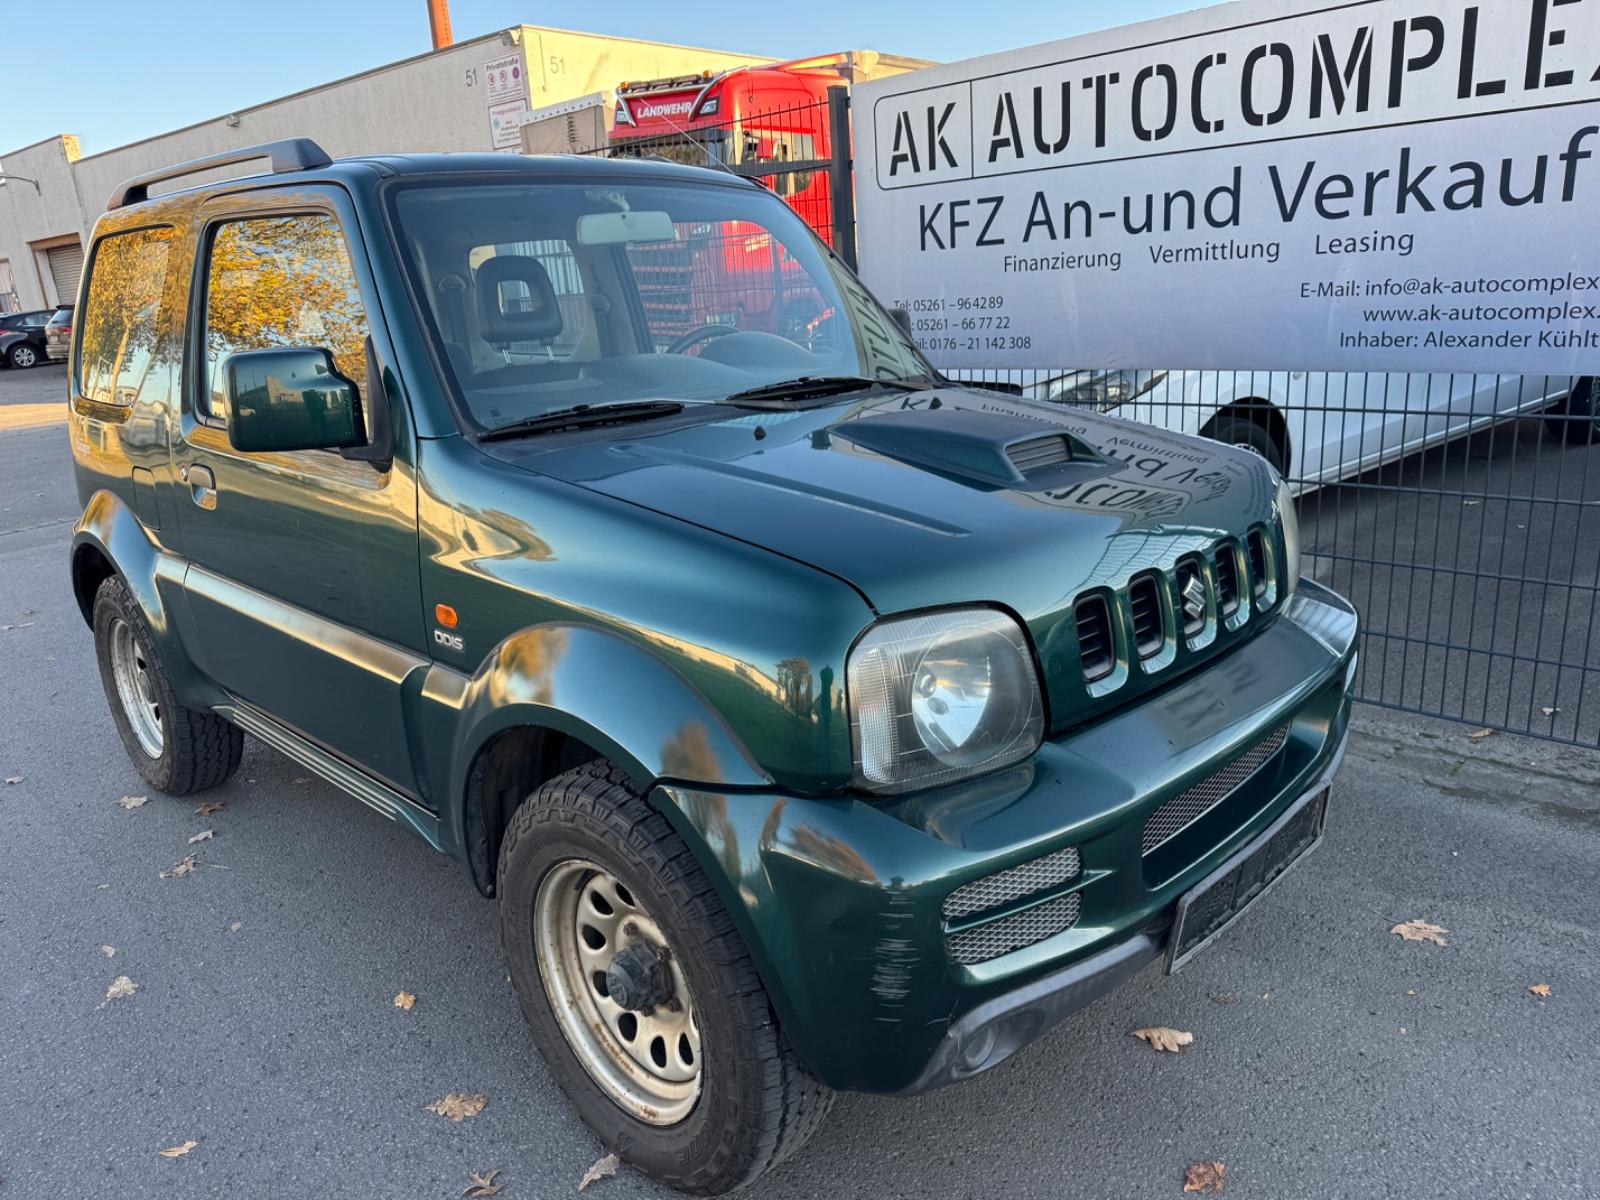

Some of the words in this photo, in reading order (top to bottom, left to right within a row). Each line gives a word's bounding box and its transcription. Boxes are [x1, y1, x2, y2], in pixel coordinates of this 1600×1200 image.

[548, 55, 566, 75] 51
[464, 67, 478, 87] 51
[889, 101, 959, 176] AK
[988, 0, 1600, 163] AUTOCOMPLE
[636, 101, 692, 119] LANDWEHR
[919, 195, 1006, 251] KFZ
[1022, 166, 1242, 243] An-und
[1268, 125, 1600, 223] Verkauf
[1003, 251, 1122, 273] Finanzierung
[1150, 239, 1281, 265] Vermittlung
[1315, 230, 1414, 256] Leasing
[1300, 281, 1361, 299] E-Mail:
[1365, 272, 1600, 297] info@ak-autocomplex
[914, 299, 945, 312] 05261
[930, 338, 957, 350] 0176
[1339, 331, 1418, 348] Inhaber:
[1424, 330, 1532, 348] Alexander
[1538, 329, 1600, 348] Kühlt
